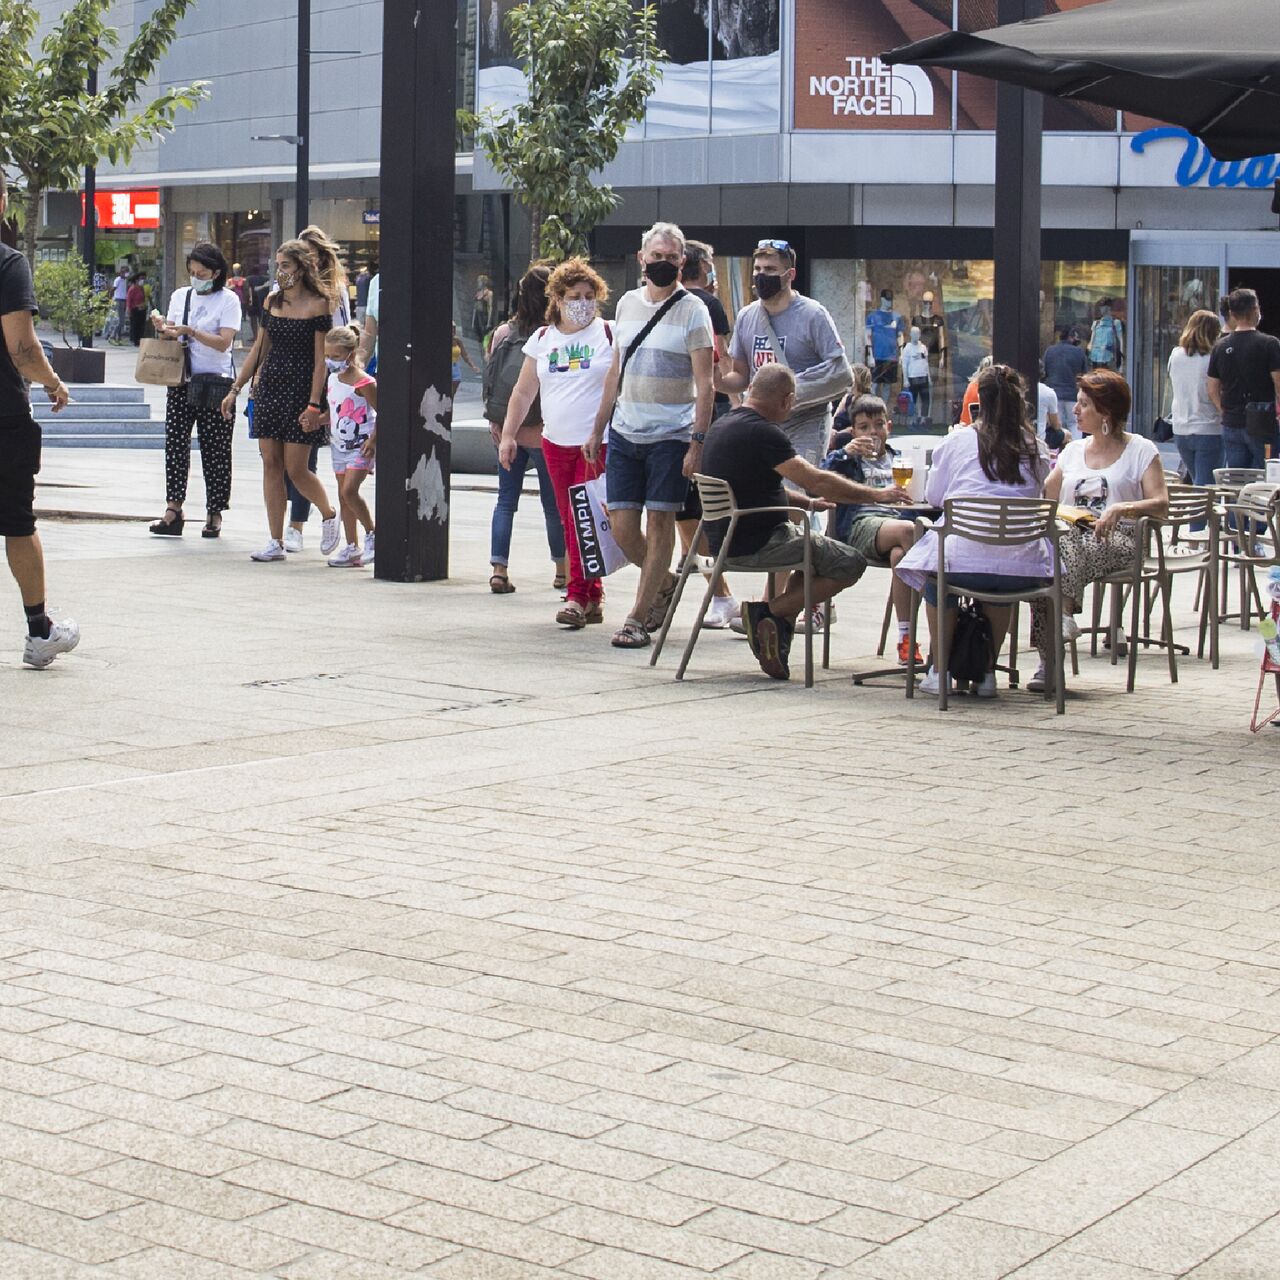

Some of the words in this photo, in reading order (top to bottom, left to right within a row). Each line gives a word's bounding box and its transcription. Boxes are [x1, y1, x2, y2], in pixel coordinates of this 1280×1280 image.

[845, 56, 891, 76] THE
[809, 76, 890, 96] NORTH
[833, 95, 891, 116] FACE
[756, 351, 778, 368] NF
[575, 489, 600, 573] OLYMPIA
